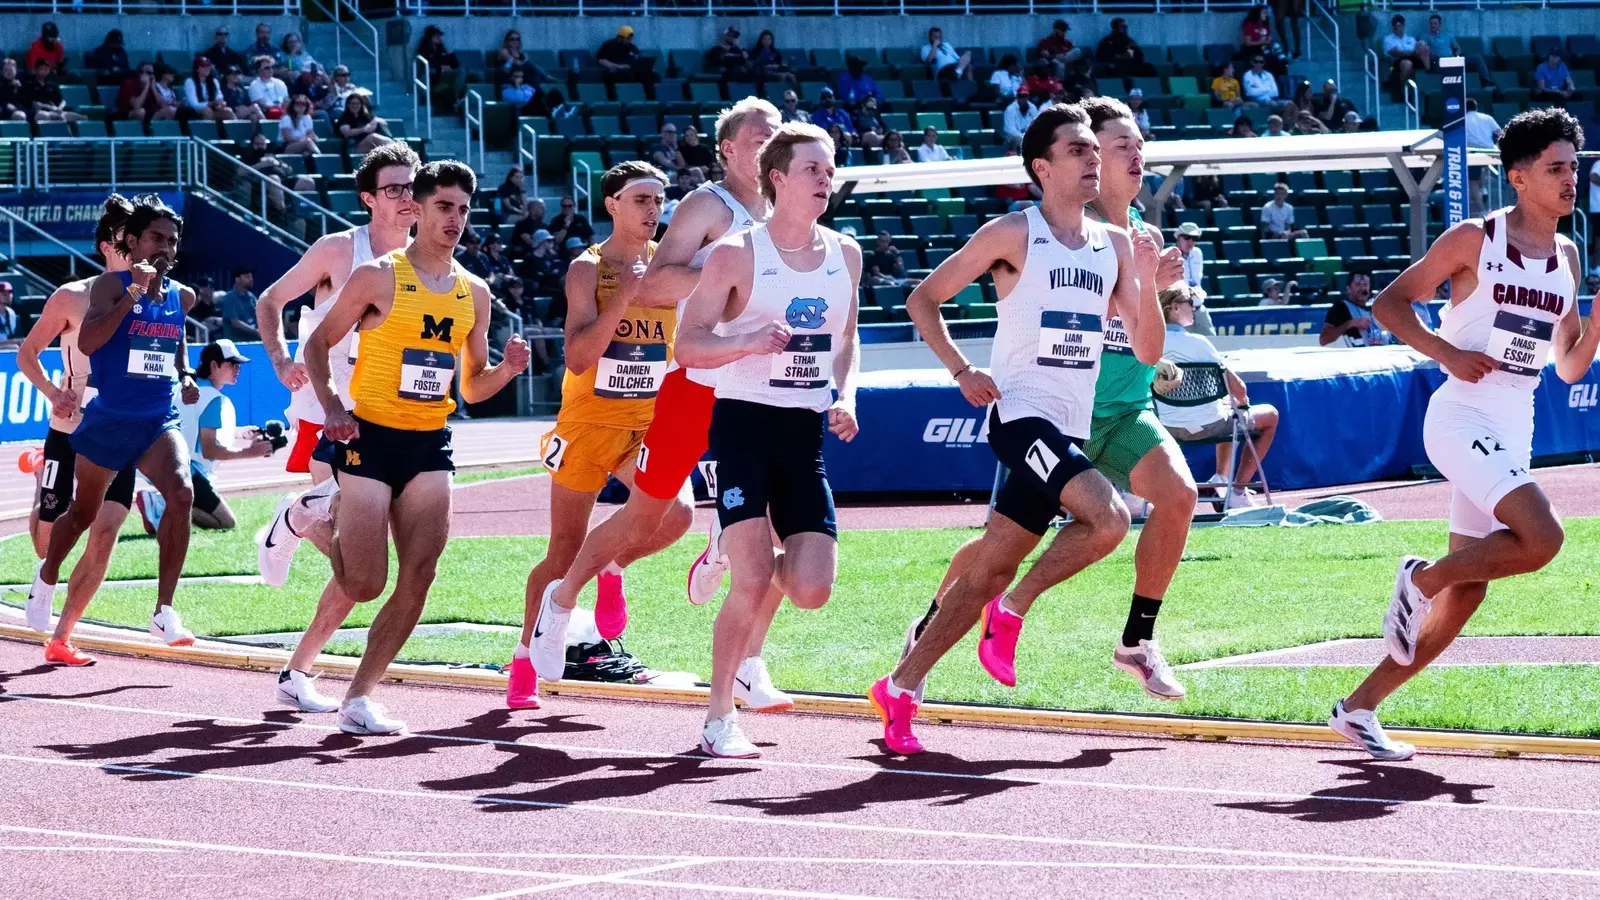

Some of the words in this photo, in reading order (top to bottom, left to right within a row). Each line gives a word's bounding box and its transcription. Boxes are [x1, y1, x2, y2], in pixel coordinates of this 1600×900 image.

[1442, 76, 1463, 84] GILL
[1448, 146, 1462, 189] TRACK
[1449, 189, 1462, 201] &
[27, 205, 61, 222] FIELD
[1449, 201, 1463, 227] FIE
[1049, 267, 1104, 297] VILLANOVA
[128, 320, 180, 339] FLORIDA
[421, 314, 454, 343] M
[1107, 319, 1124, 329] TOM
[1064, 333, 1083, 343] LIAM
[1103, 330, 1129, 344] ALFRE
[1510, 336, 1537, 351] ANASS
[143, 353, 166, 362] PARVEJ
[1052, 344, 1091, 357] MURPHY
[1503, 348, 1535, 365] ESSAYI
[793, 355, 816, 364] ETHAN
[143, 362, 164, 372] KHAN
[616, 364, 651, 375] DAMIEN
[784, 366, 820, 378] STRAND
[421, 369, 437, 380] NICK
[413, 379, 441, 392] FOSTER
[608, 375, 654, 389] DILCHER
[345, 449, 361, 466] M
[545, 437, 562, 468] 2
[1028, 444, 1050, 475] 7
[46, 461, 54, 487] 1
